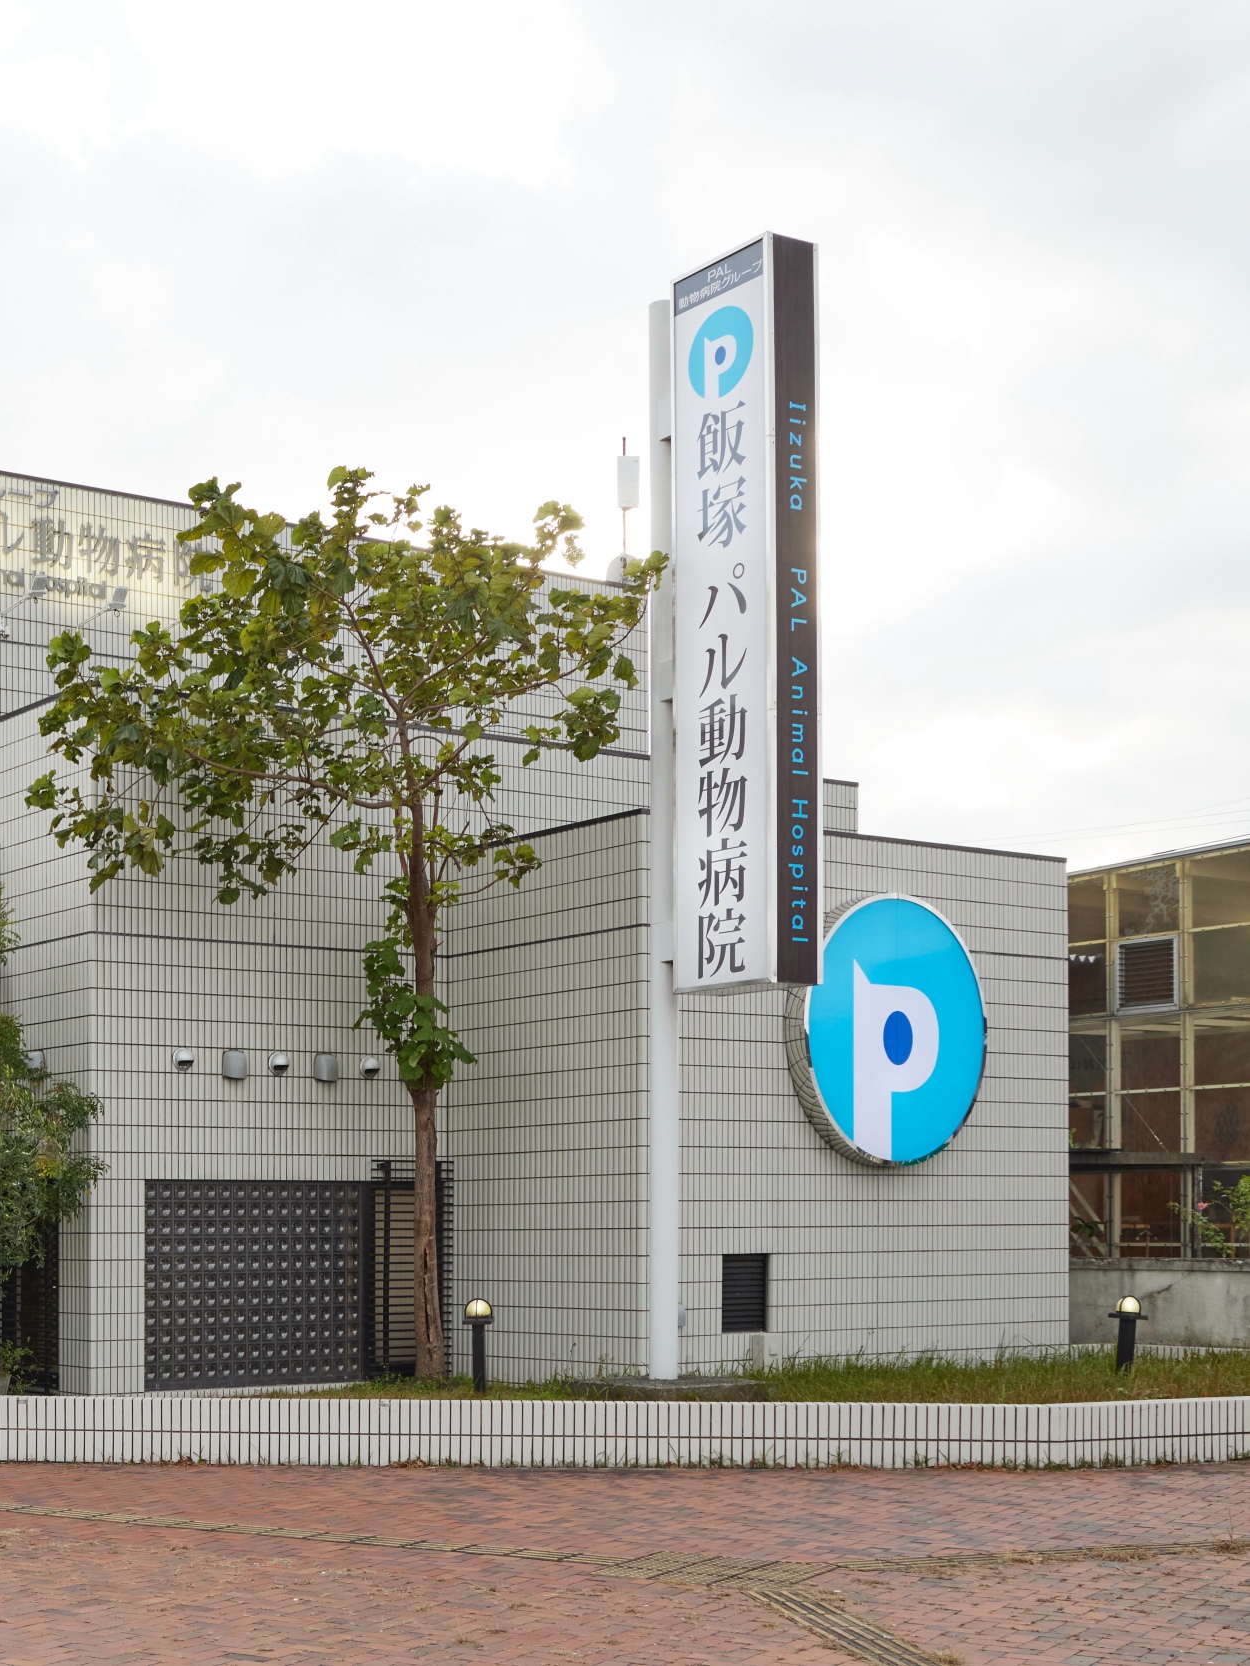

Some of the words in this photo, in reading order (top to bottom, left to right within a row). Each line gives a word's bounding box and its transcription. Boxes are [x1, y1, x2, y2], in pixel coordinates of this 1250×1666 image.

[678, 258, 763, 311] 動物病院グループ
[707, 263, 732, 283] PAL
[789, 401, 807, 511] Iizuka
[790, 567, 807, 631] PAL
[697, 400, 748, 979] 飯塚パル動物病院
[791, 656, 808, 775] Animal
[789, 800, 808, 943] Hospital
